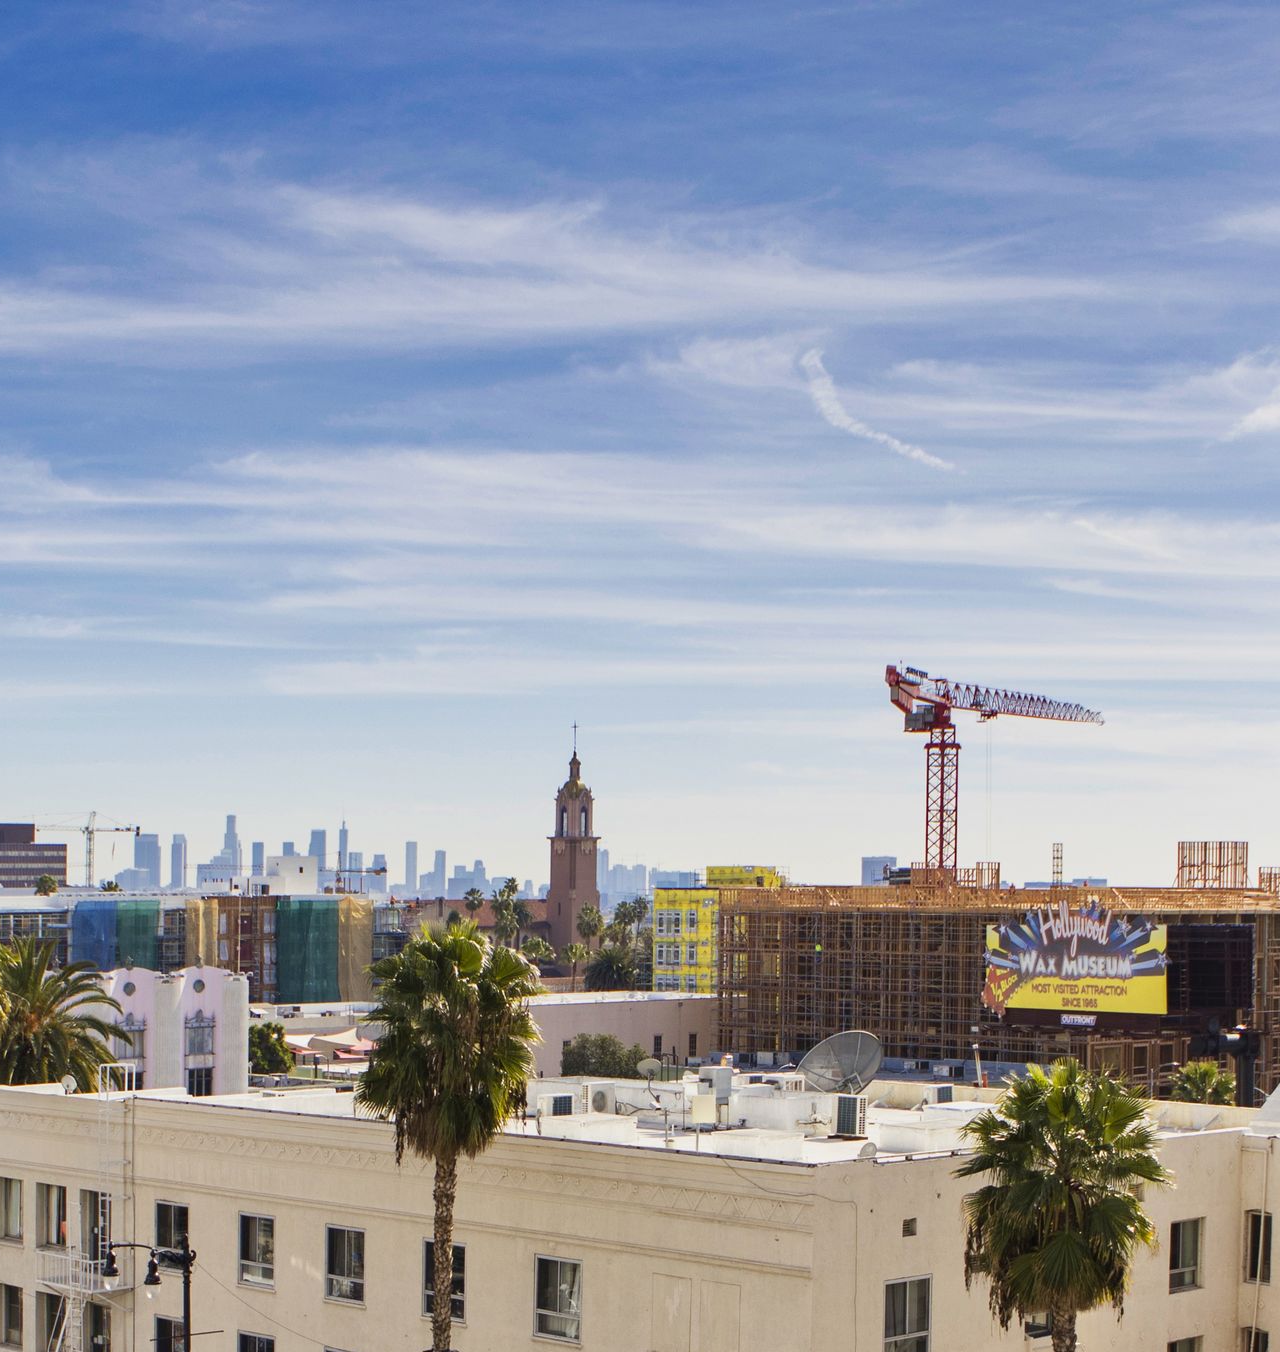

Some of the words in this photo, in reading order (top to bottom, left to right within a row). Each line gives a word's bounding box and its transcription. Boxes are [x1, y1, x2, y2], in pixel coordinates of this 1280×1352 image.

[1036, 899, 1112, 957] Hollywood
[1020, 949, 1057, 976] WAX
[1062, 950, 1133, 978] MUSEUM
[1031, 983, 1051, 993] MOST
[1052, 984, 1080, 994] VISITED
[1081, 985, 1128, 996] ATTRACTION
[1061, 998, 1081, 1007] SINCE
[1061, 1015, 1097, 1026] OUTFRONT
